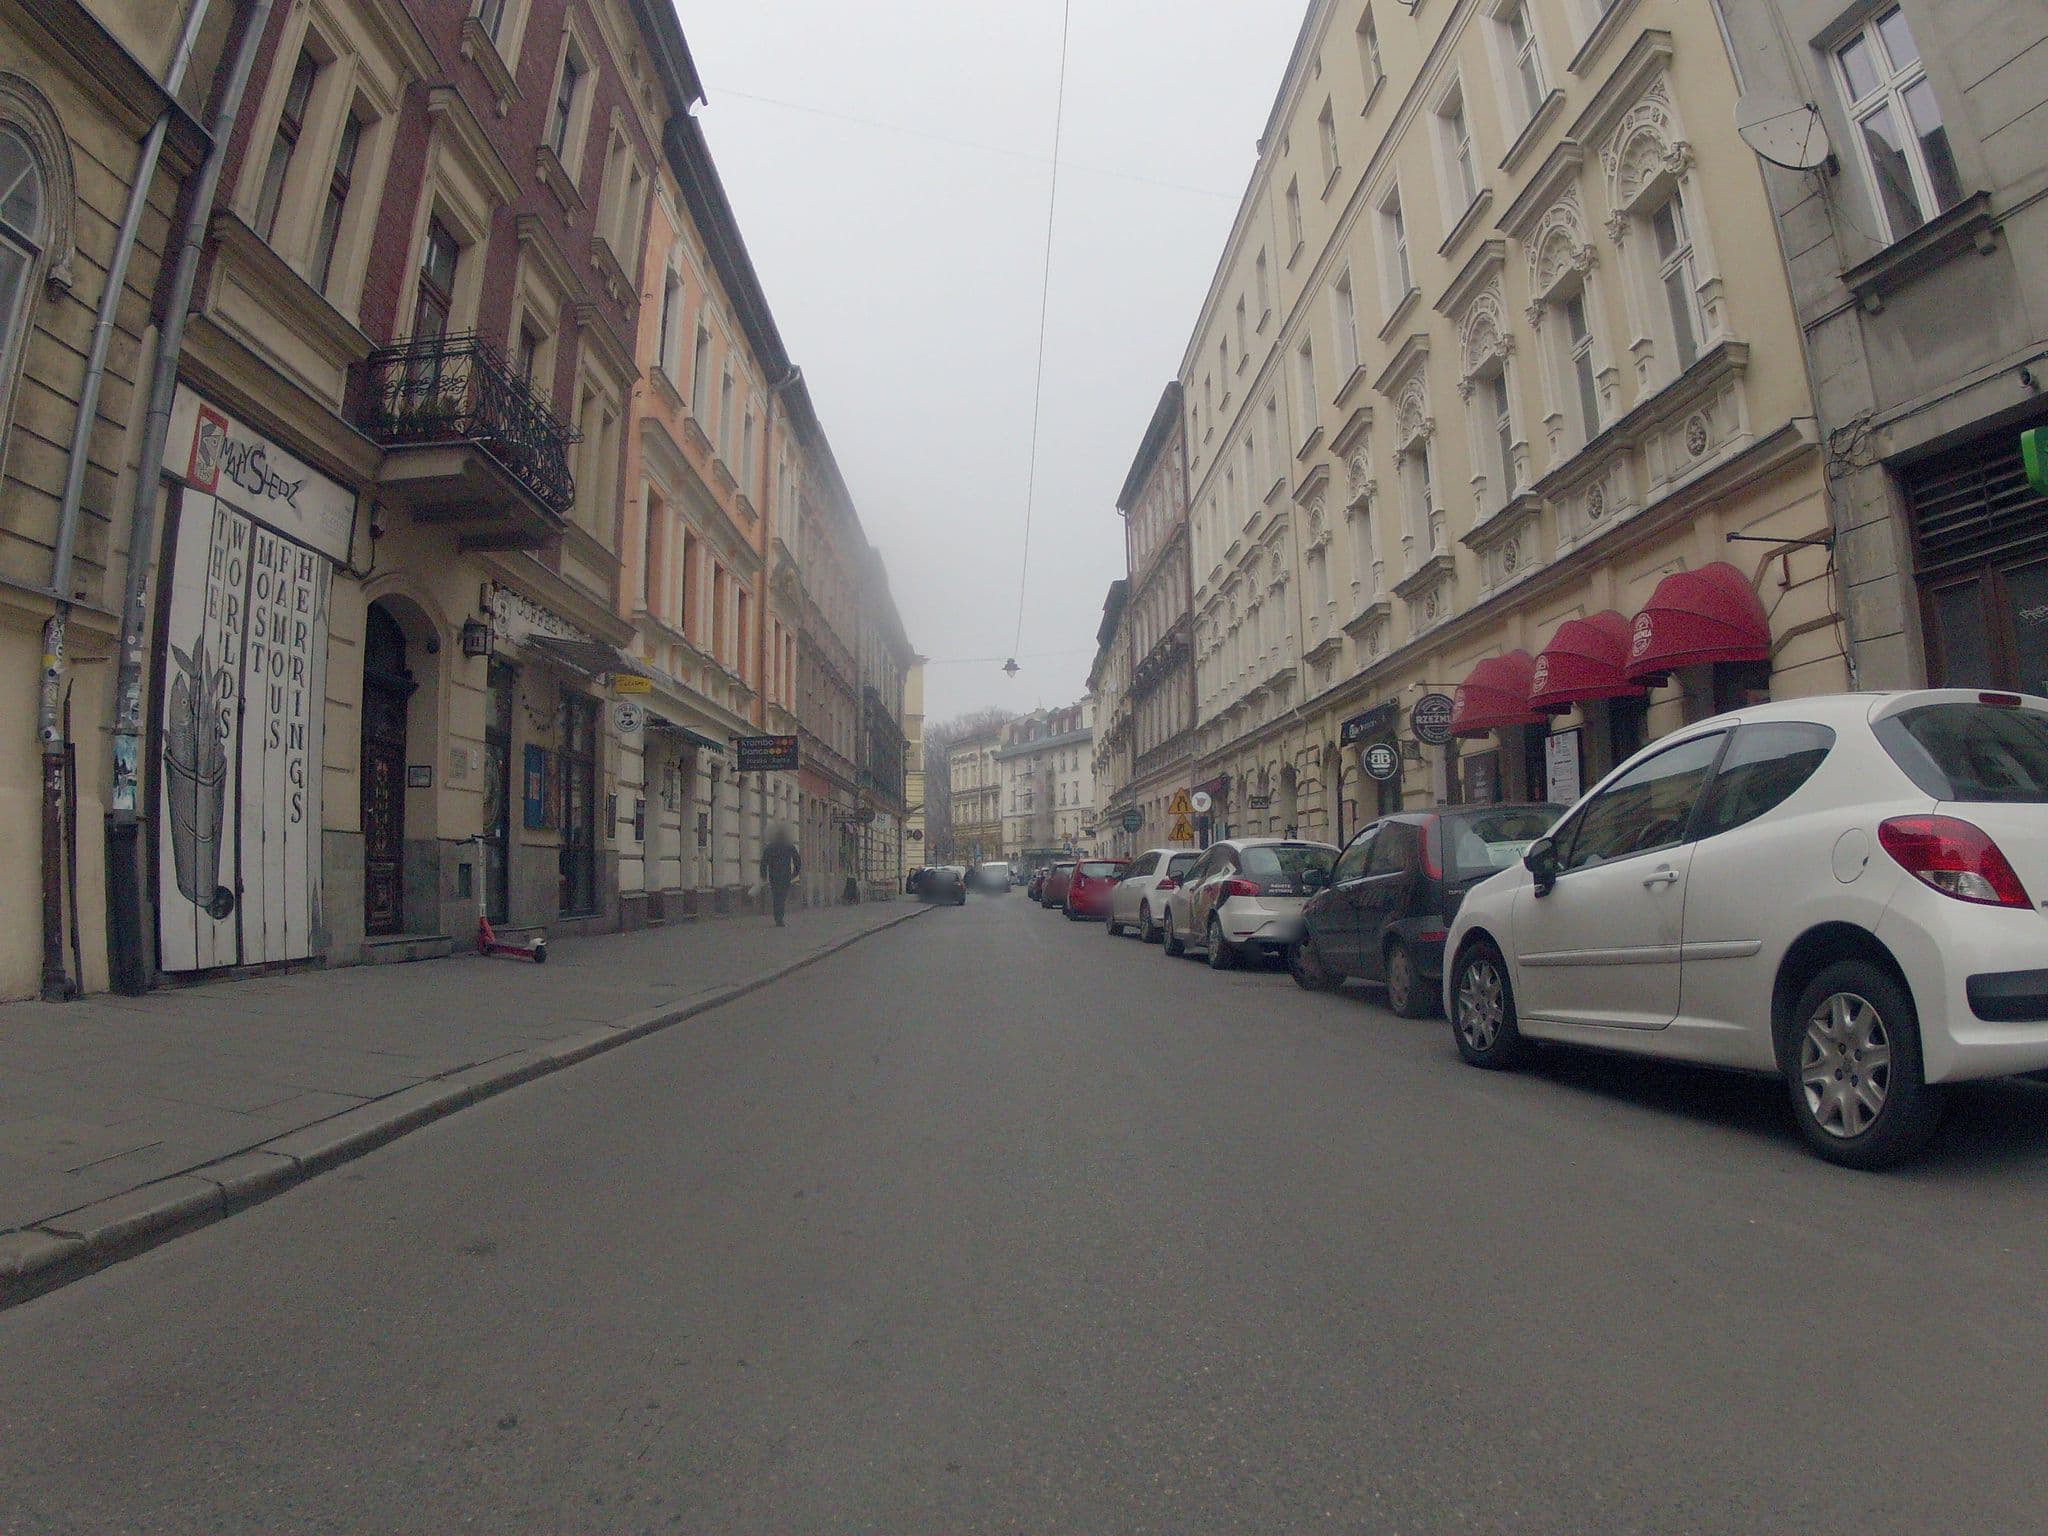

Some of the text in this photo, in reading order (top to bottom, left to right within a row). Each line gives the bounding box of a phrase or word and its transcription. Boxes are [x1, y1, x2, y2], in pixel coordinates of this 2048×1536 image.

[209, 509, 229, 620] THE
[252, 534, 274, 673] MOST
[270, 545, 292, 749] FAMOUS
[289, 551, 314, 824] HERRINGS
